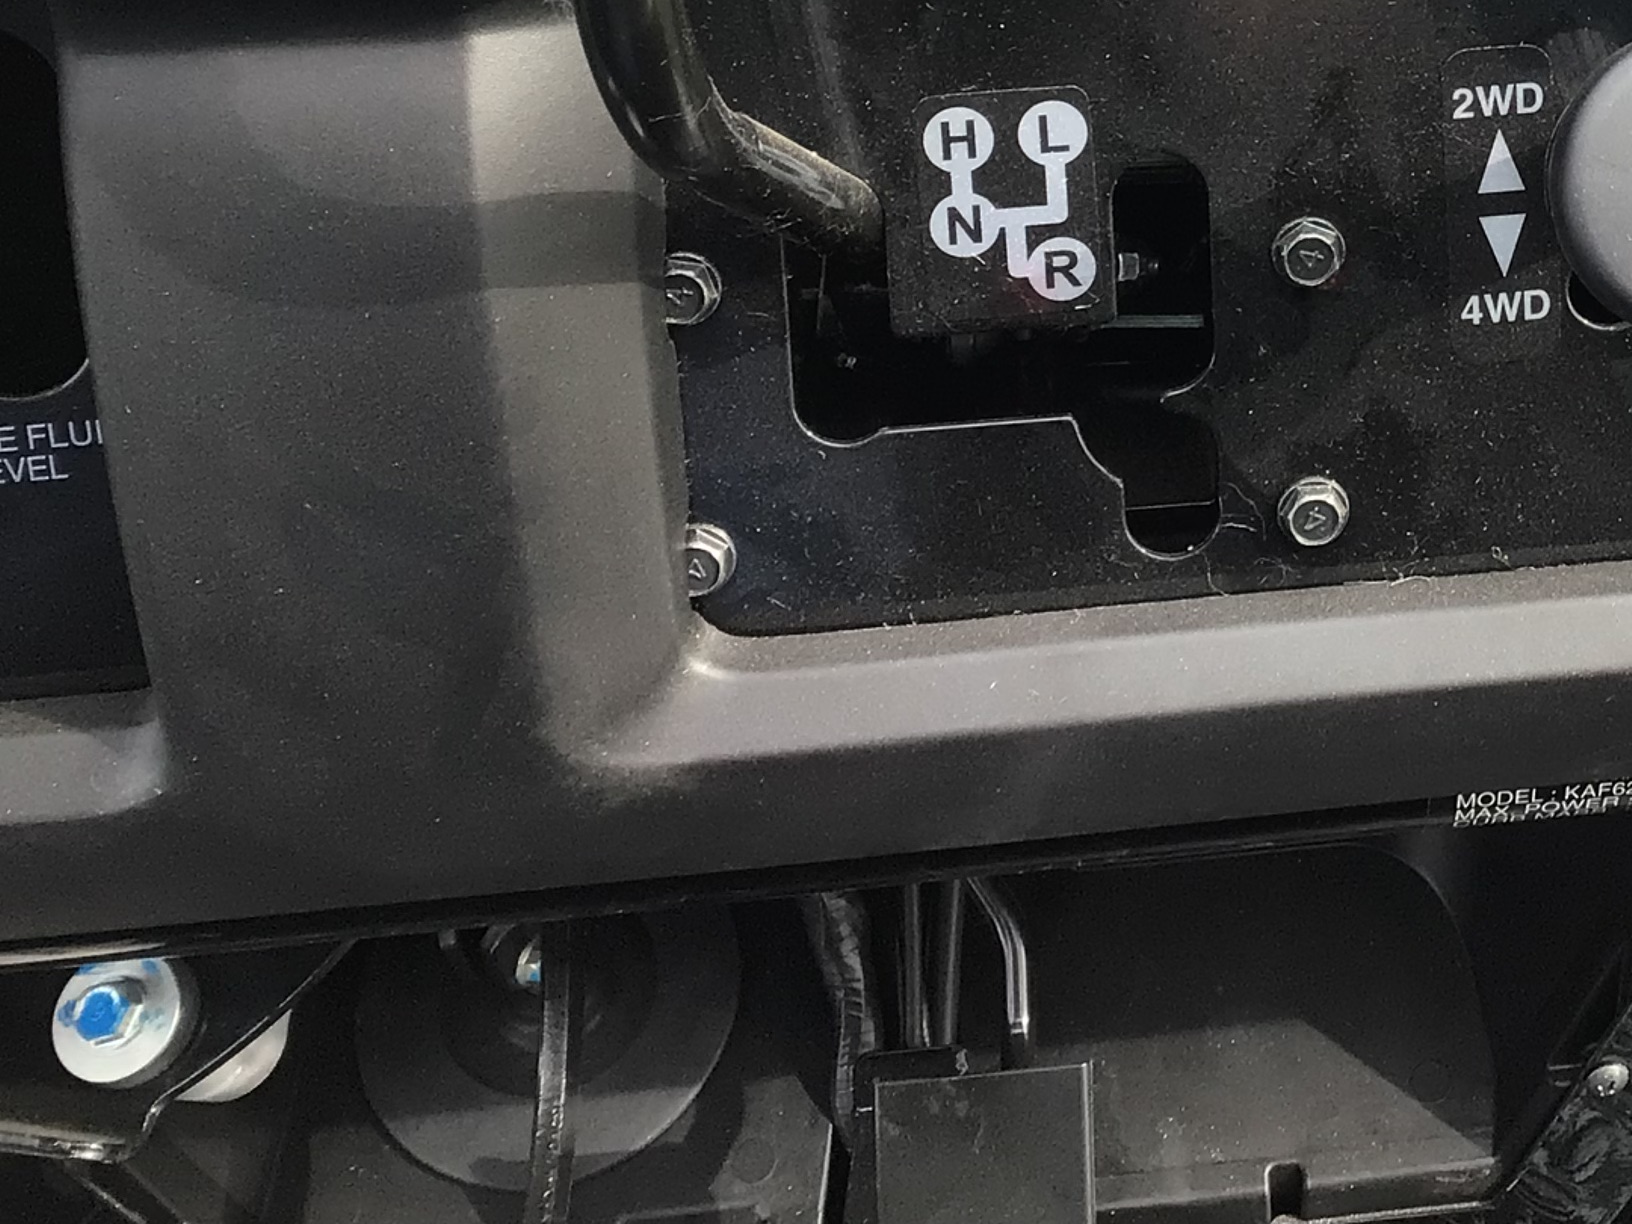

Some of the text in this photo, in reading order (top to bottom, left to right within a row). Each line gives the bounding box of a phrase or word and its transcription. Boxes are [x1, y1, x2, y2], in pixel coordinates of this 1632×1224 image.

[1452, 81, 1544, 120] 2WD
[940, 114, 1070, 161] H L
[946, 205, 1083, 289] N R
[1461, 289, 1551, 325] 4WD
[1456, 788, 1544, 809] MODEL
